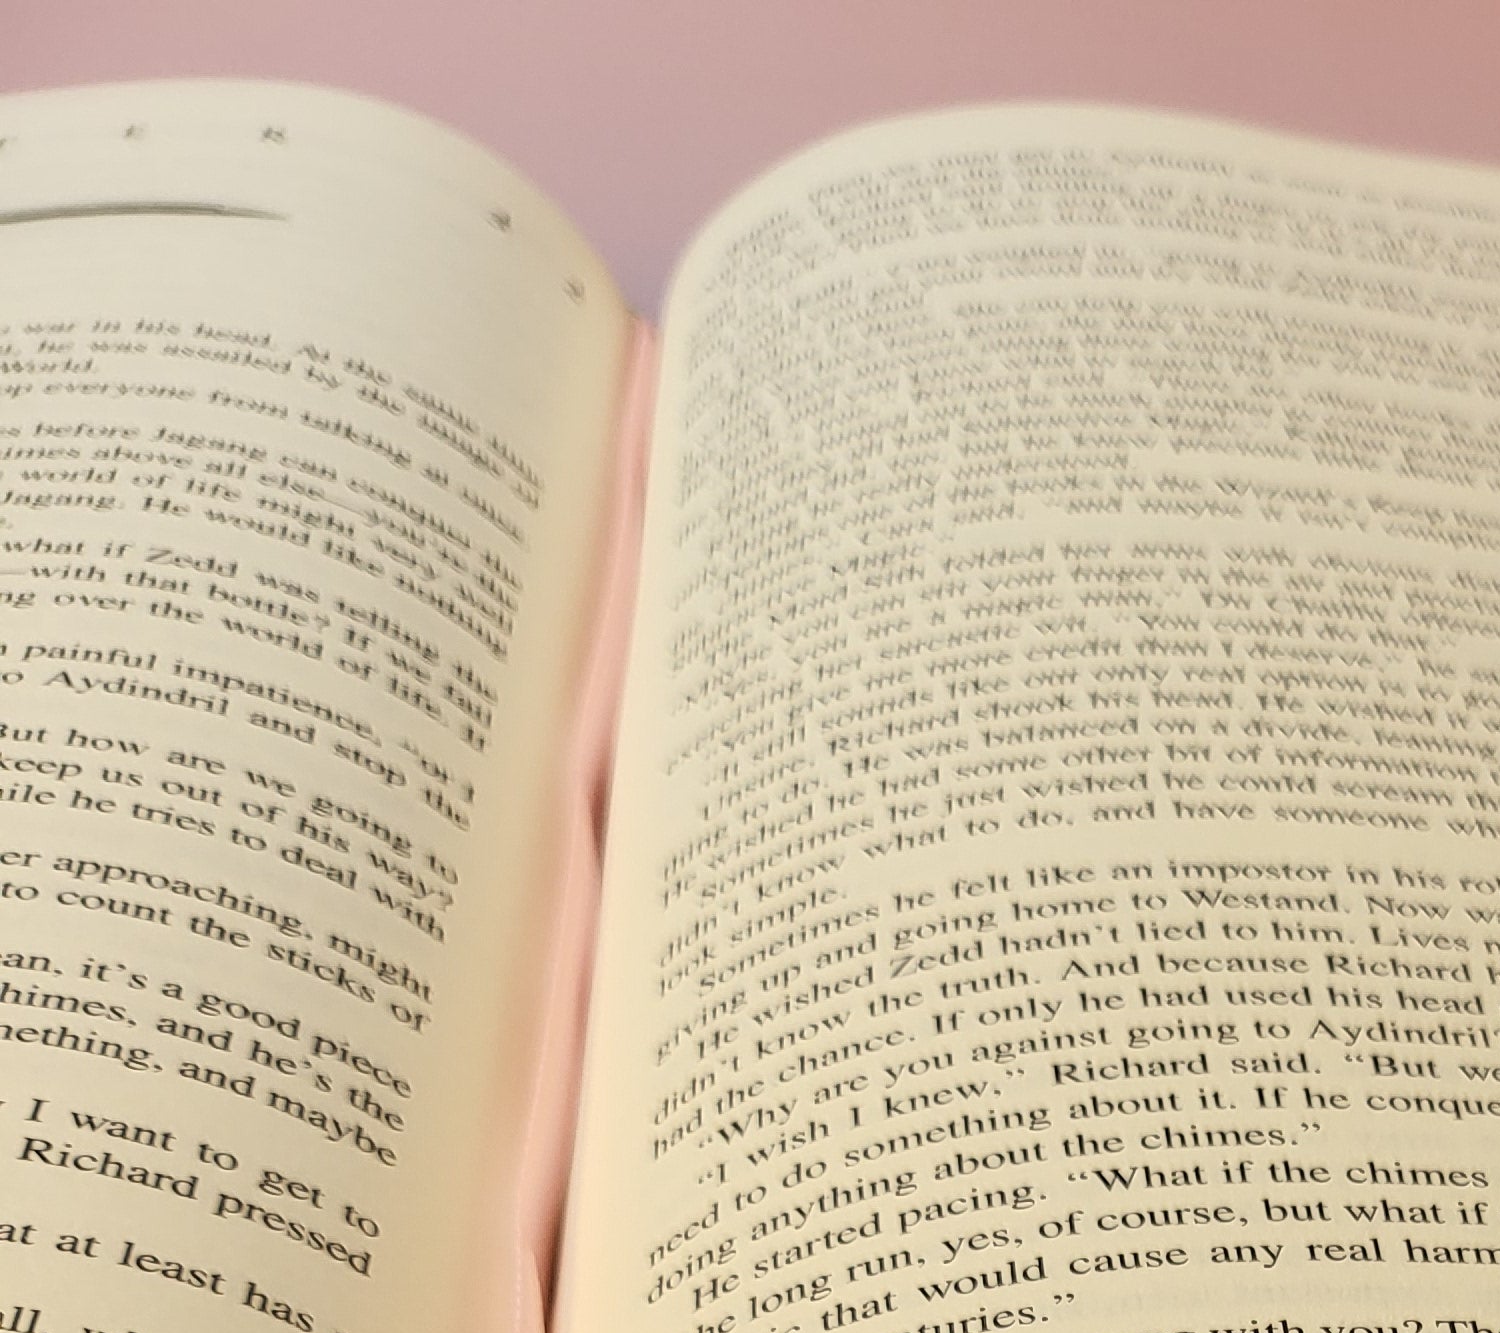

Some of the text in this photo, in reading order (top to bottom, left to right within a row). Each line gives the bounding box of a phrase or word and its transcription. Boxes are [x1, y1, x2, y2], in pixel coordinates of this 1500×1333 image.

[22, 644, 157, 672] painful
[44, 670, 315, 745] Aydindril and
[66, 728, 414, 858] how are we going
[0, 880, 375, 1004] to count the sticks
[52, 851, 434, 1004] approaching, might
[162, 982, 184, 1000] a
[197, 994, 301, 1041] good
[312, 1034, 412, 1099] piece
[757, 1011, 851, 1059] know
[869, 992, 924, 1017] the
[939, 968, 1041, 1000] truth.
[1062, 955, 1141, 980] And
[1156, 954, 1310, 975] because
[1326, 955, 1473, 983] Richard
[814, 1076, 869, 1104] are
[884, 1049, 955, 1089] you
[970, 1022, 1113, 1064] against
[1129, 1020, 1241, 1049] going
[1255, 1020, 1291, 1040] to
[156, 1018, 233, 1053] and
[348, 1087, 405, 1132] the
[179, 1061, 397, 1167] and maybe
[747, 1118, 830, 1168] wish
[849, 1106, 866, 1129] I
[1053, 1054, 1209, 1085] Richard
[1232, 1053, 1320, 1075] said.
[16, 1136, 372, 1277] Richard pressed
[24, 1098, 380, 1238] I want to get to
[56, 1233, 101, 1258] at
[117, 1242, 227, 1295] least
[242, 1282, 313, 1333] has
[693, 1274, 741, 1311] He
[753, 1212, 882, 1280] started
[899, 1184, 1046, 1235] pacing.
[1222, 1161, 1254, 1184] if
[1268, 1161, 1331, 1184] the
[1346, 1162, 1489, 1189] chimes
[750, 1273, 832, 1320] long
[847, 1247, 925, 1283] run,
[943, 1228, 1023, 1264] yes,
[1038, 1211, 1084, 1239] of
[1097, 1204, 1248, 1231] course,
[1264, 1199, 1332, 1222] but
[1344, 1200, 1445, 1224] what
[1457, 1202, 1488, 1225] if
[821, 1292, 898, 1331] that
[917, 1257, 1047, 1302] would
[1069, 1244, 1189, 1275] cause
[1210, 1243, 1284, 1268] any
[1306, 1238, 1387, 1262] real
